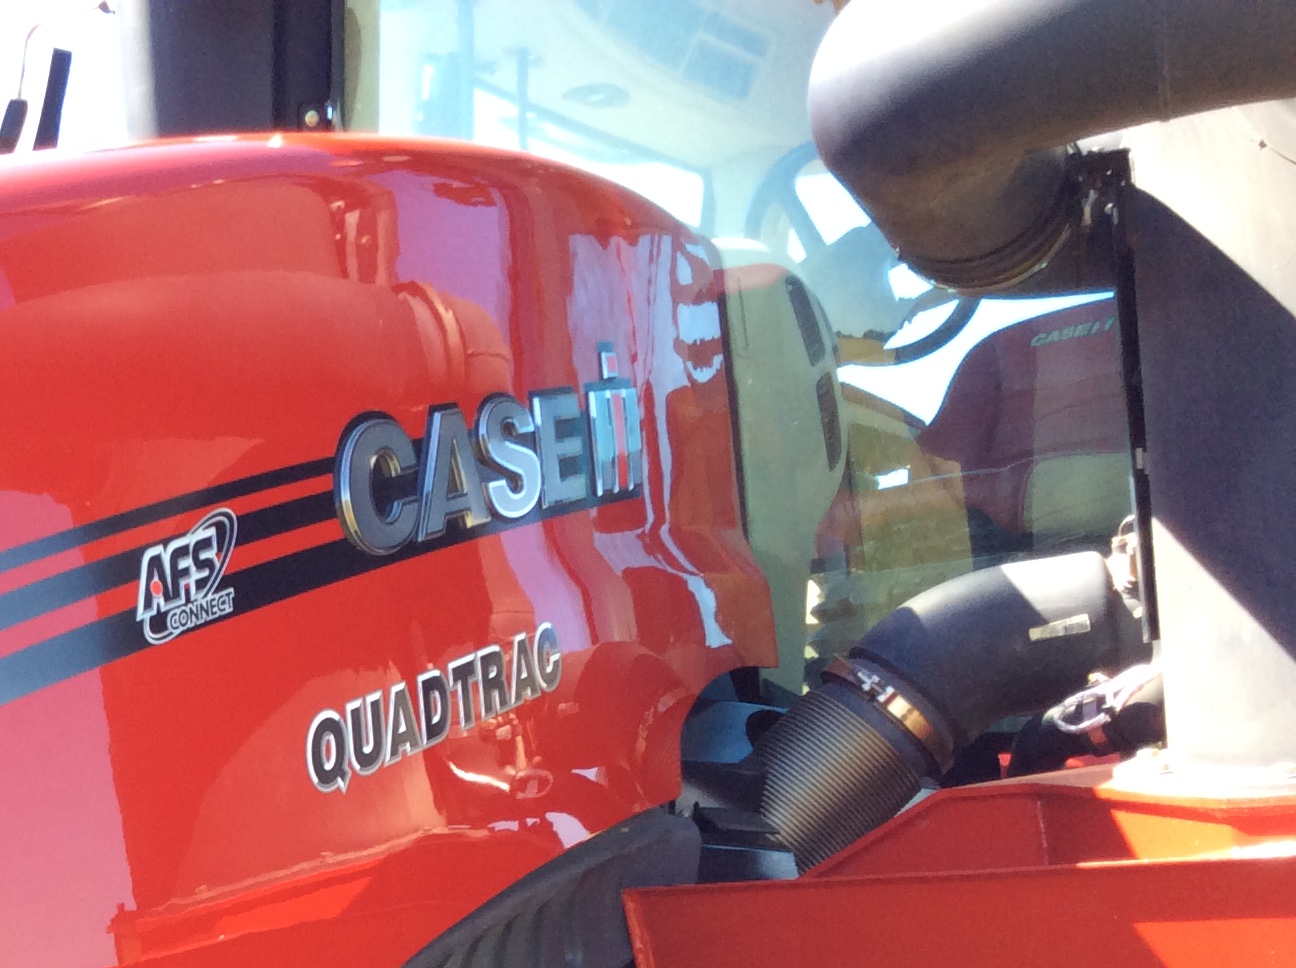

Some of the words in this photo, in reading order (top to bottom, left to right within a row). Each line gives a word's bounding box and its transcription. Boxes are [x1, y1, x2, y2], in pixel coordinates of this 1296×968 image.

[136, 525, 219, 622] AFS
[167, 587, 235, 631] CONNECT
[306, 622, 562, 795] QUADTRAC
